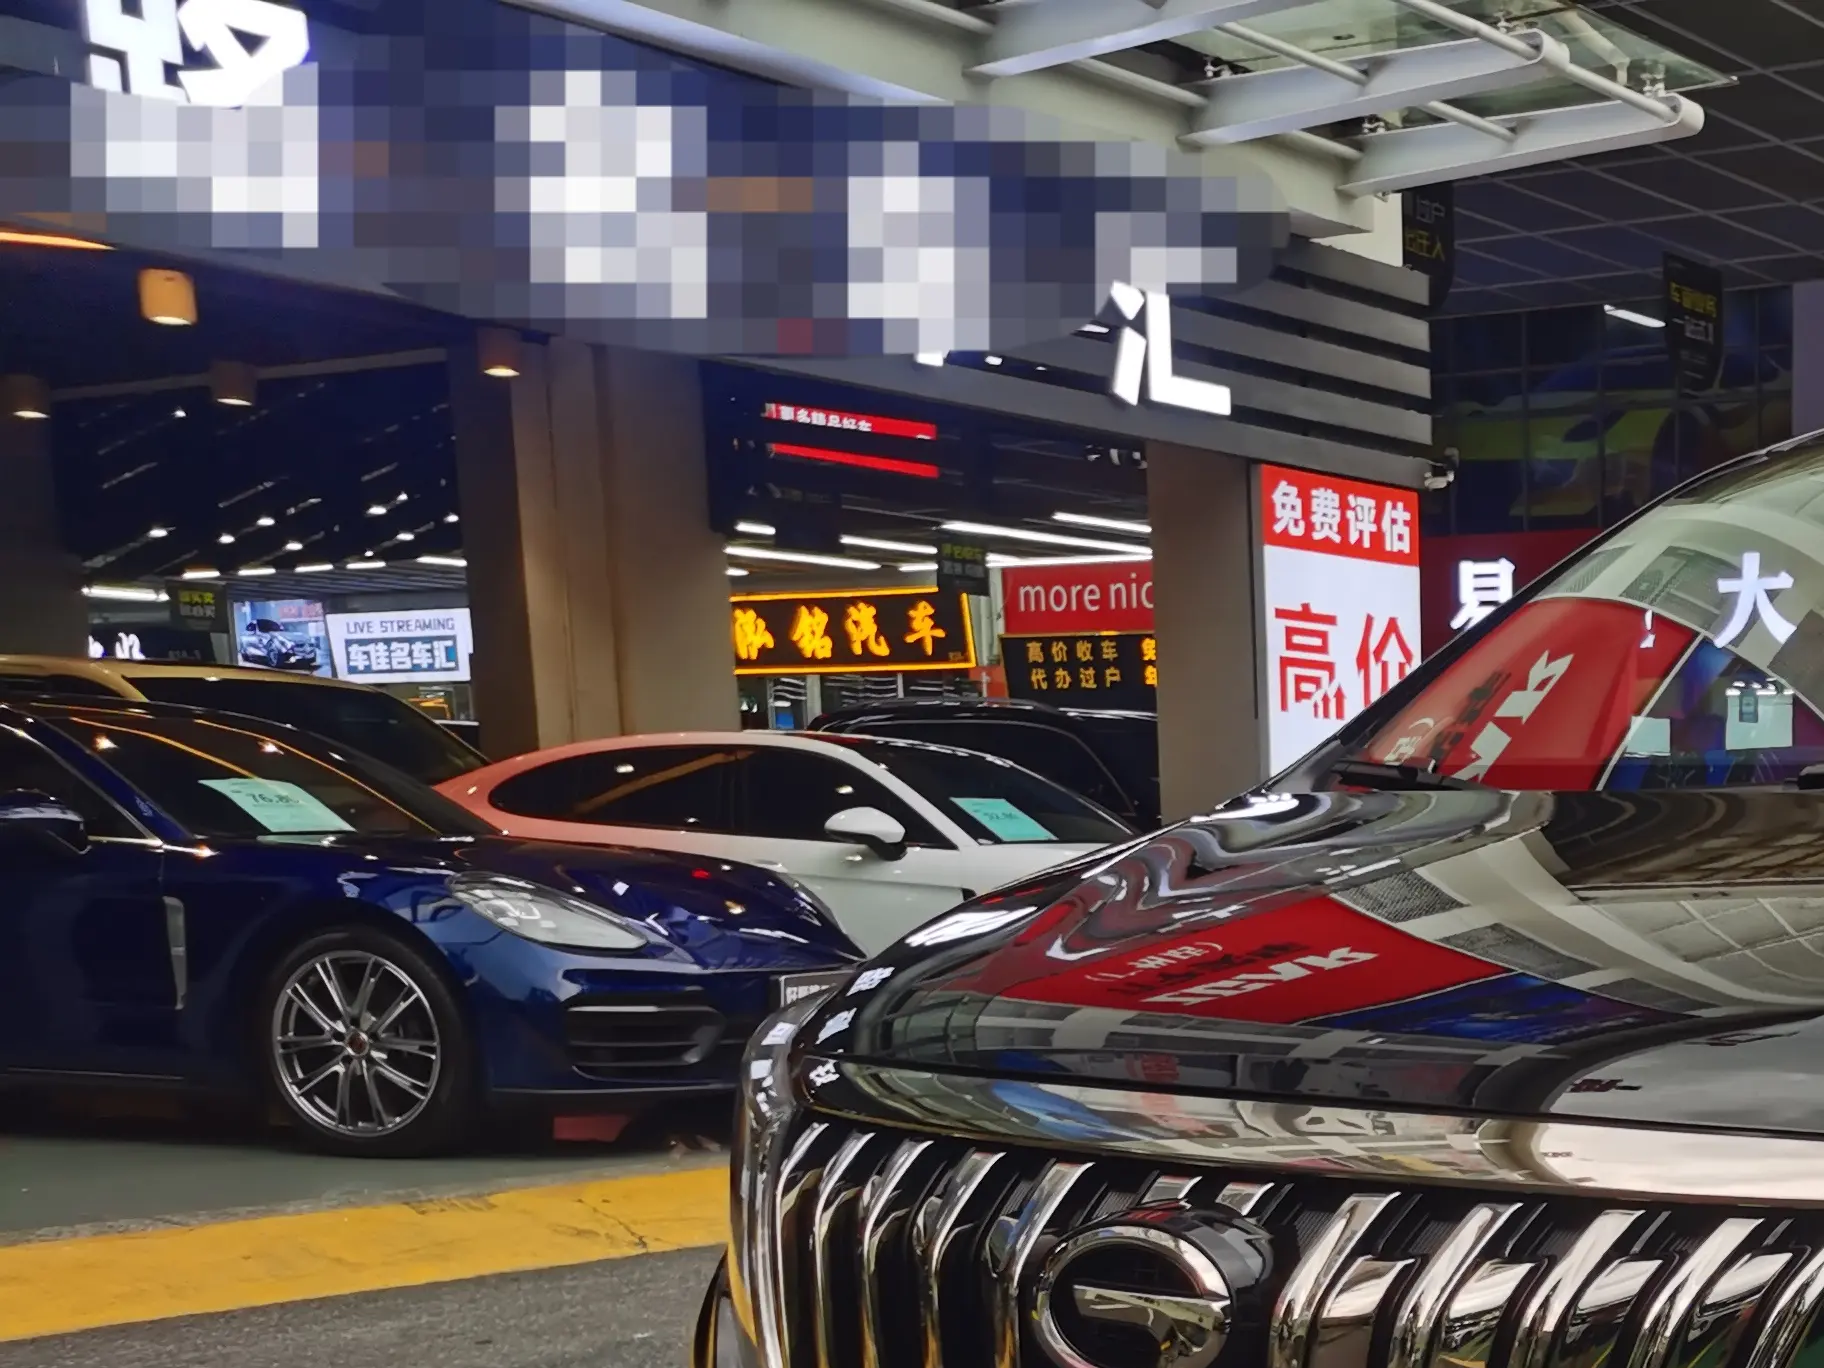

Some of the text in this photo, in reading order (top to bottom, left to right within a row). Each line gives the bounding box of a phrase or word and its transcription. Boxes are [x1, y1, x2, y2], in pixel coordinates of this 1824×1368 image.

[1271, 480, 1412, 554] 免费评估
[1018, 584, 1101, 612] more
[345, 617, 456, 635] LIVE STREAMING
[347, 640, 457, 671] 车佳名车汇
[1026, 640, 1119, 663] 高价收车
[1274, 603, 1415, 721] 高价
[1031, 667, 1121, 690] 代办过户
